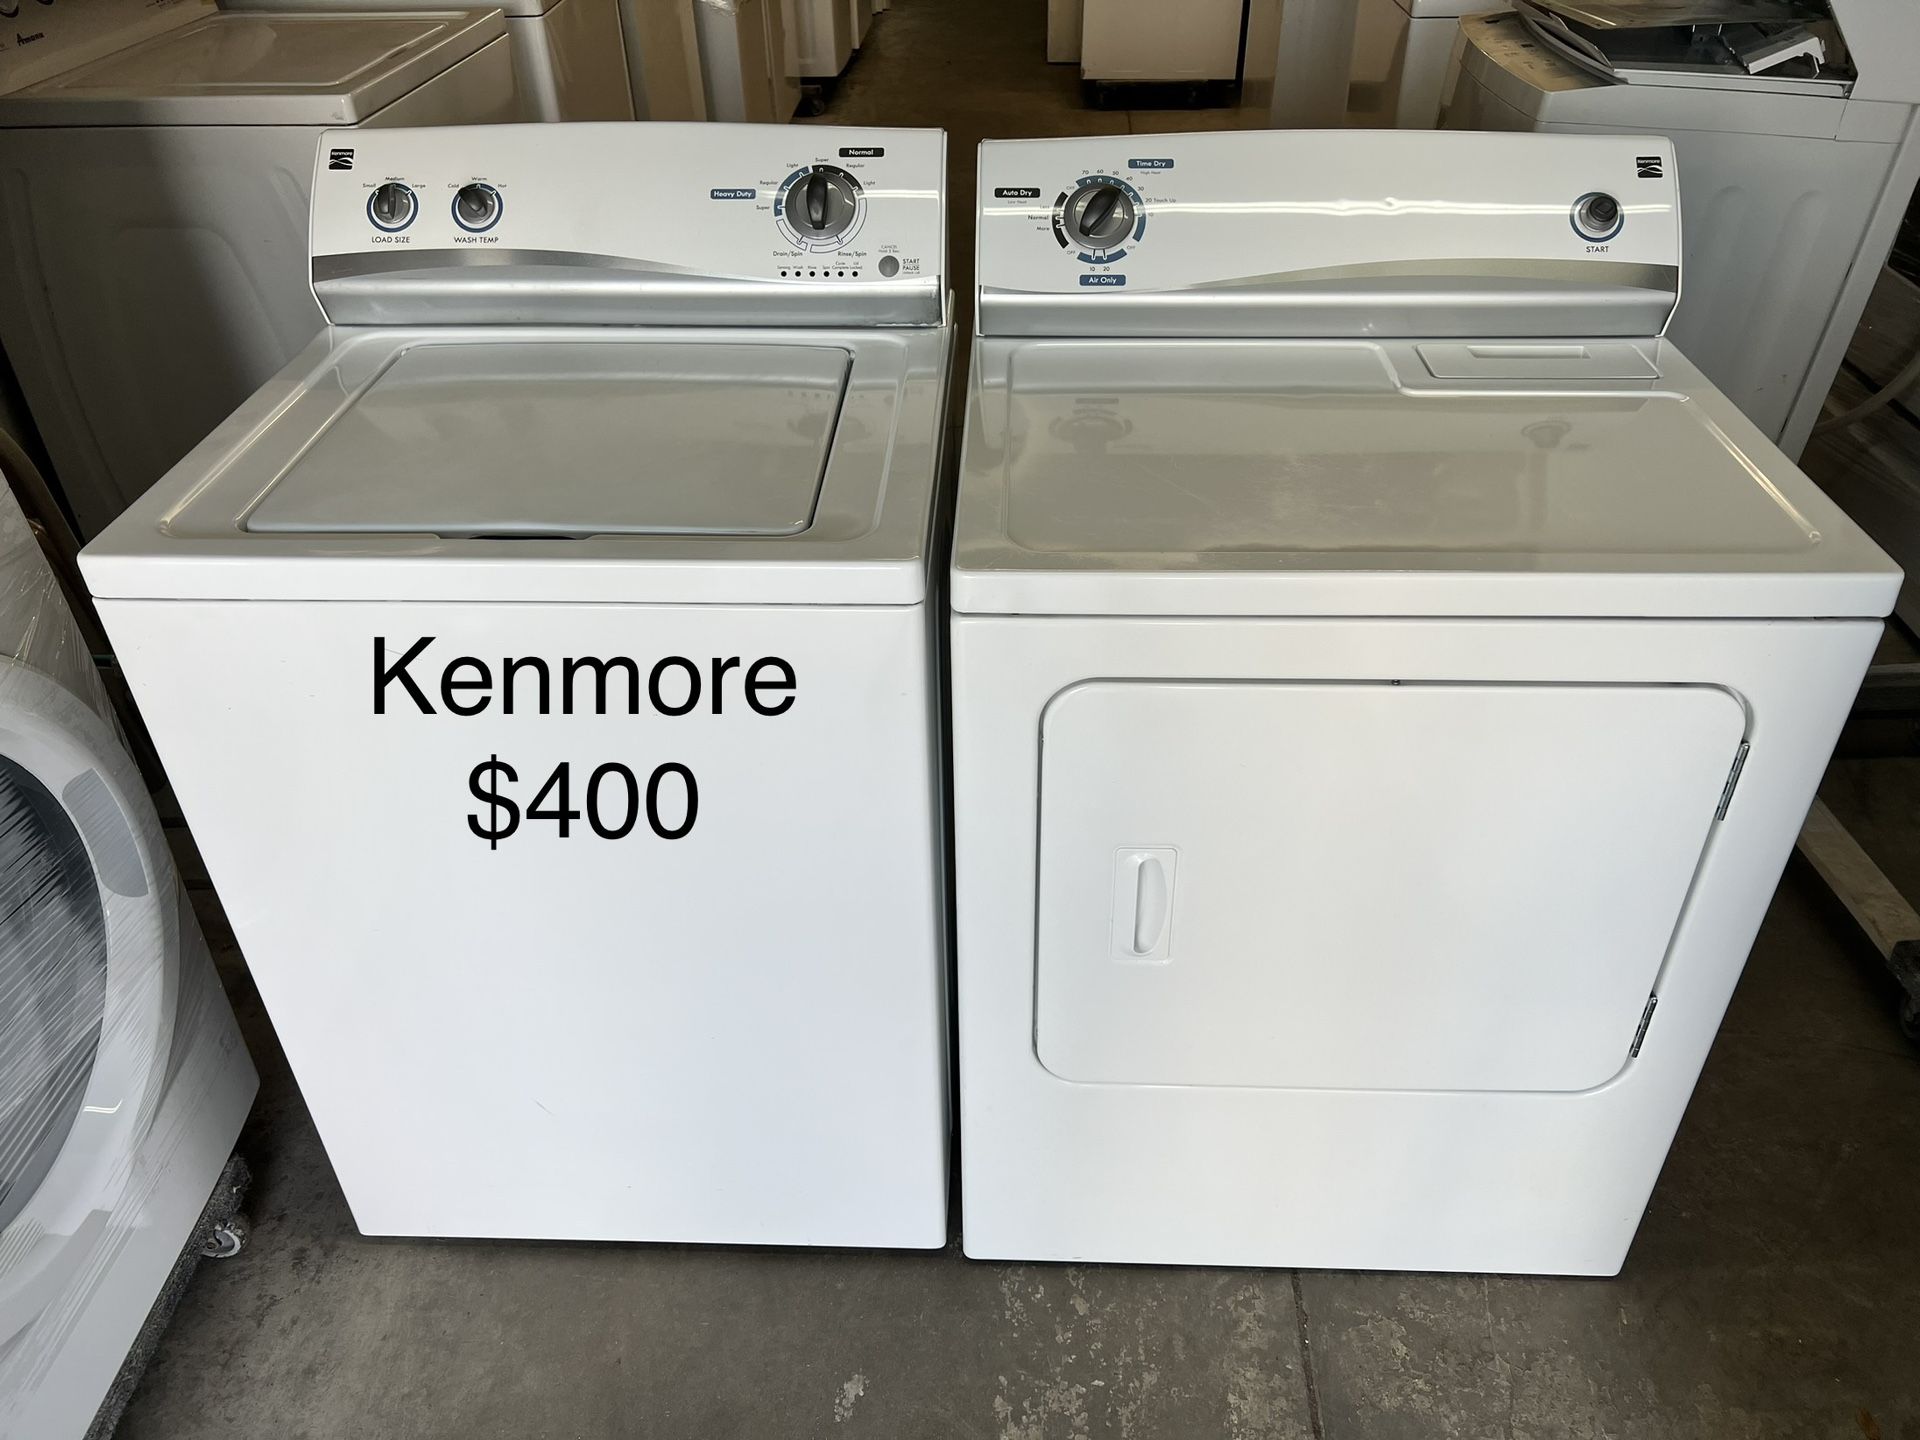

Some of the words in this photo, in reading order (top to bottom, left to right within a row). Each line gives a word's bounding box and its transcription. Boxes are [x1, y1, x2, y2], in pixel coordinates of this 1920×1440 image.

[1153, 160, 1166, 168] Dry
[1020, 189, 1033, 197] Dry
[1100, 276, 1117, 284] Only
